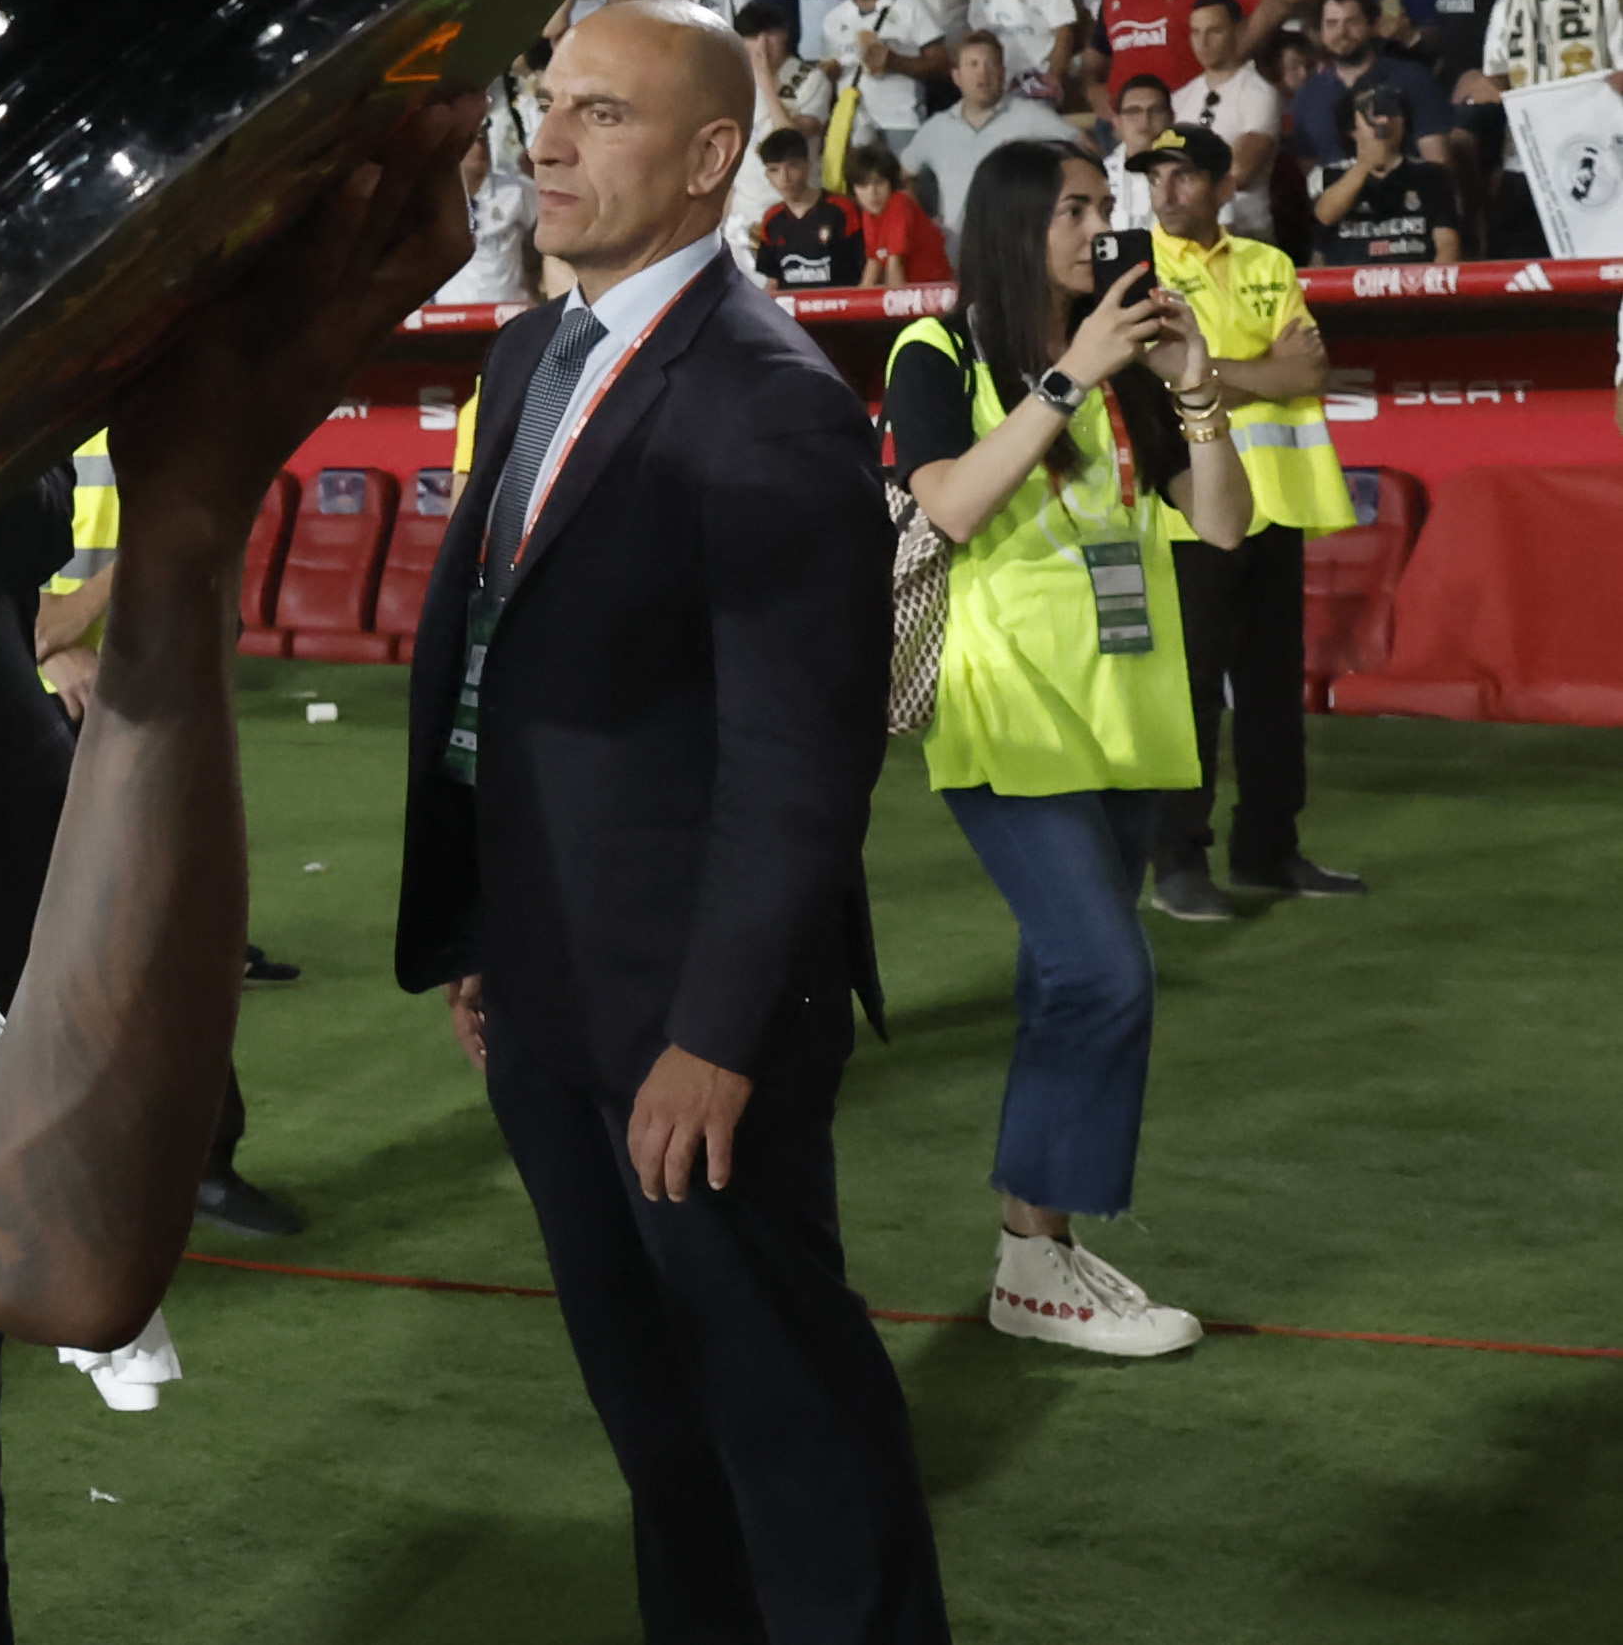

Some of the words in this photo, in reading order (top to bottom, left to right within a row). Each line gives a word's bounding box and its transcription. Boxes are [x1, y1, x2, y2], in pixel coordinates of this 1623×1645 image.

[1353, 267, 1402, 298] COPA
[1424, 265, 1460, 295] REY
[1394, 380, 1535, 406] SEAT
